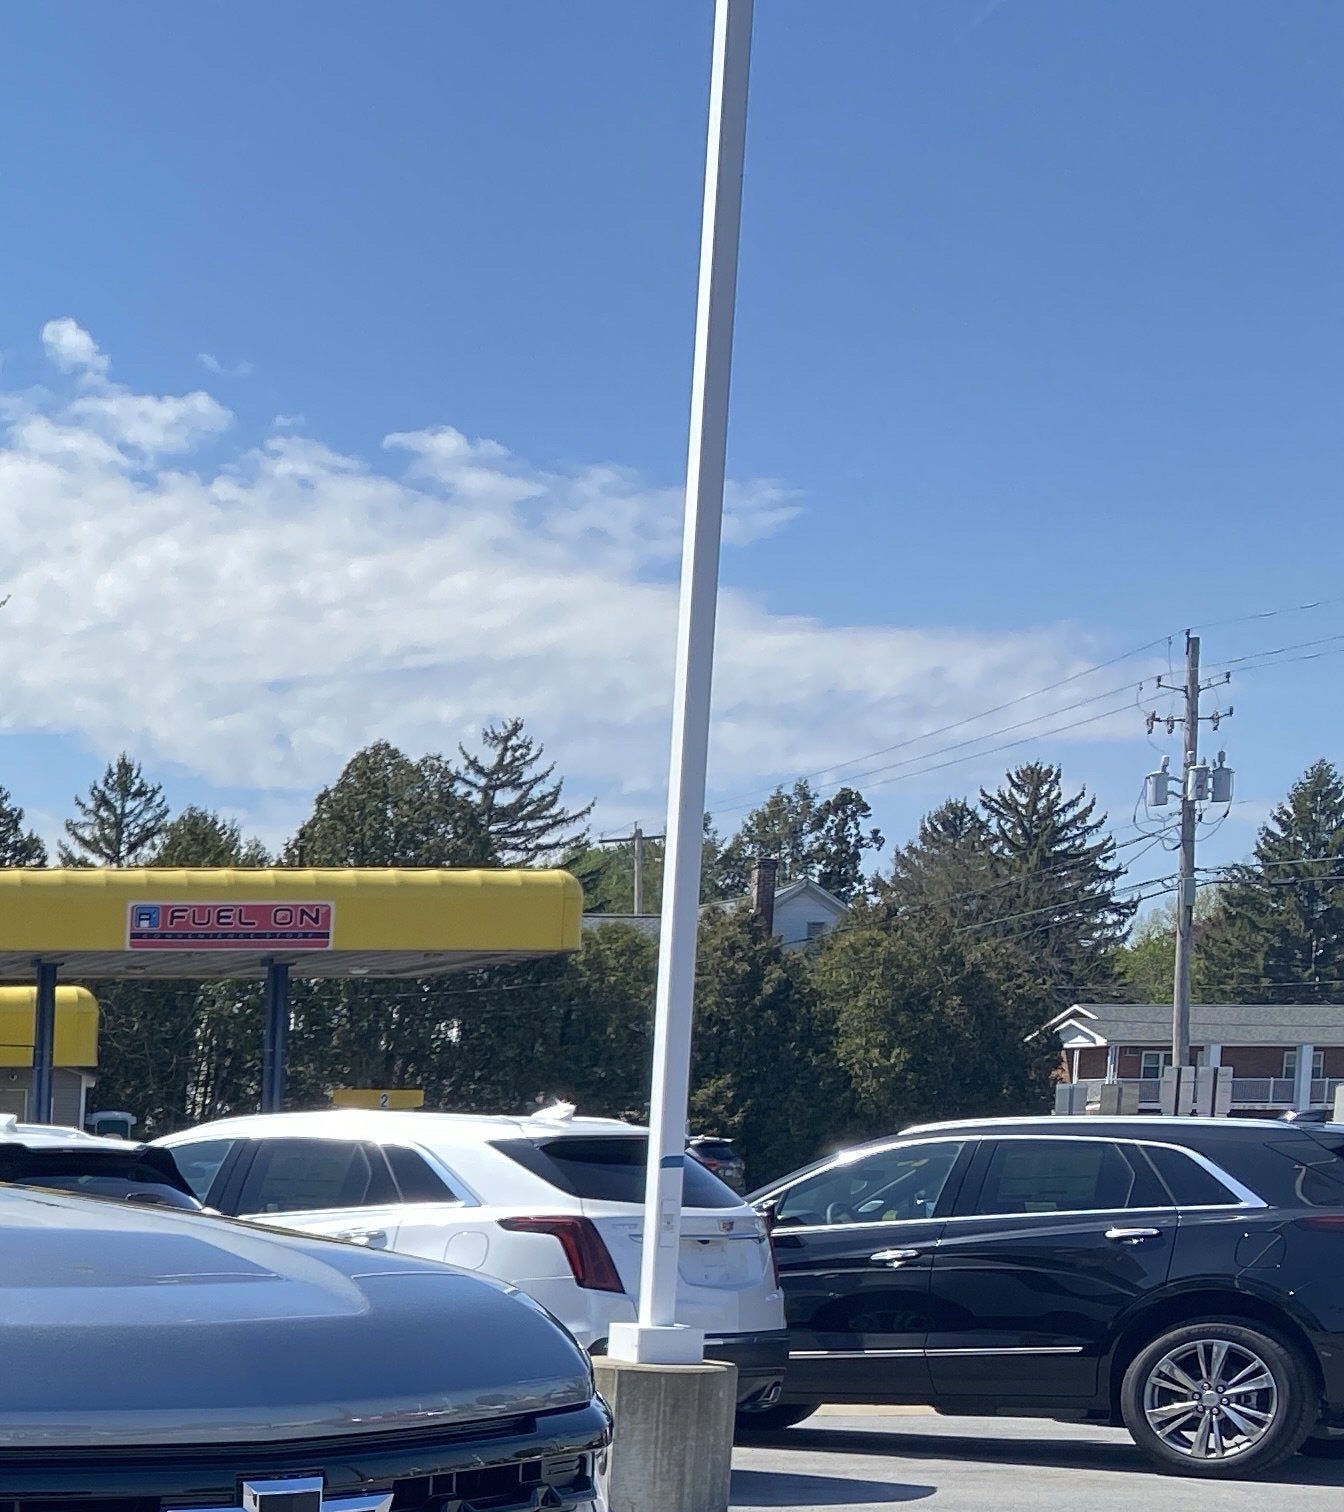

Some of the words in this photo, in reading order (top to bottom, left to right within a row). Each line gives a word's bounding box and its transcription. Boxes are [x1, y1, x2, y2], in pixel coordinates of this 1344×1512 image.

[168, 907, 256, 927] FUEL
[273, 907, 321, 927] ON
[380, 1093, 389, 1108] 2
